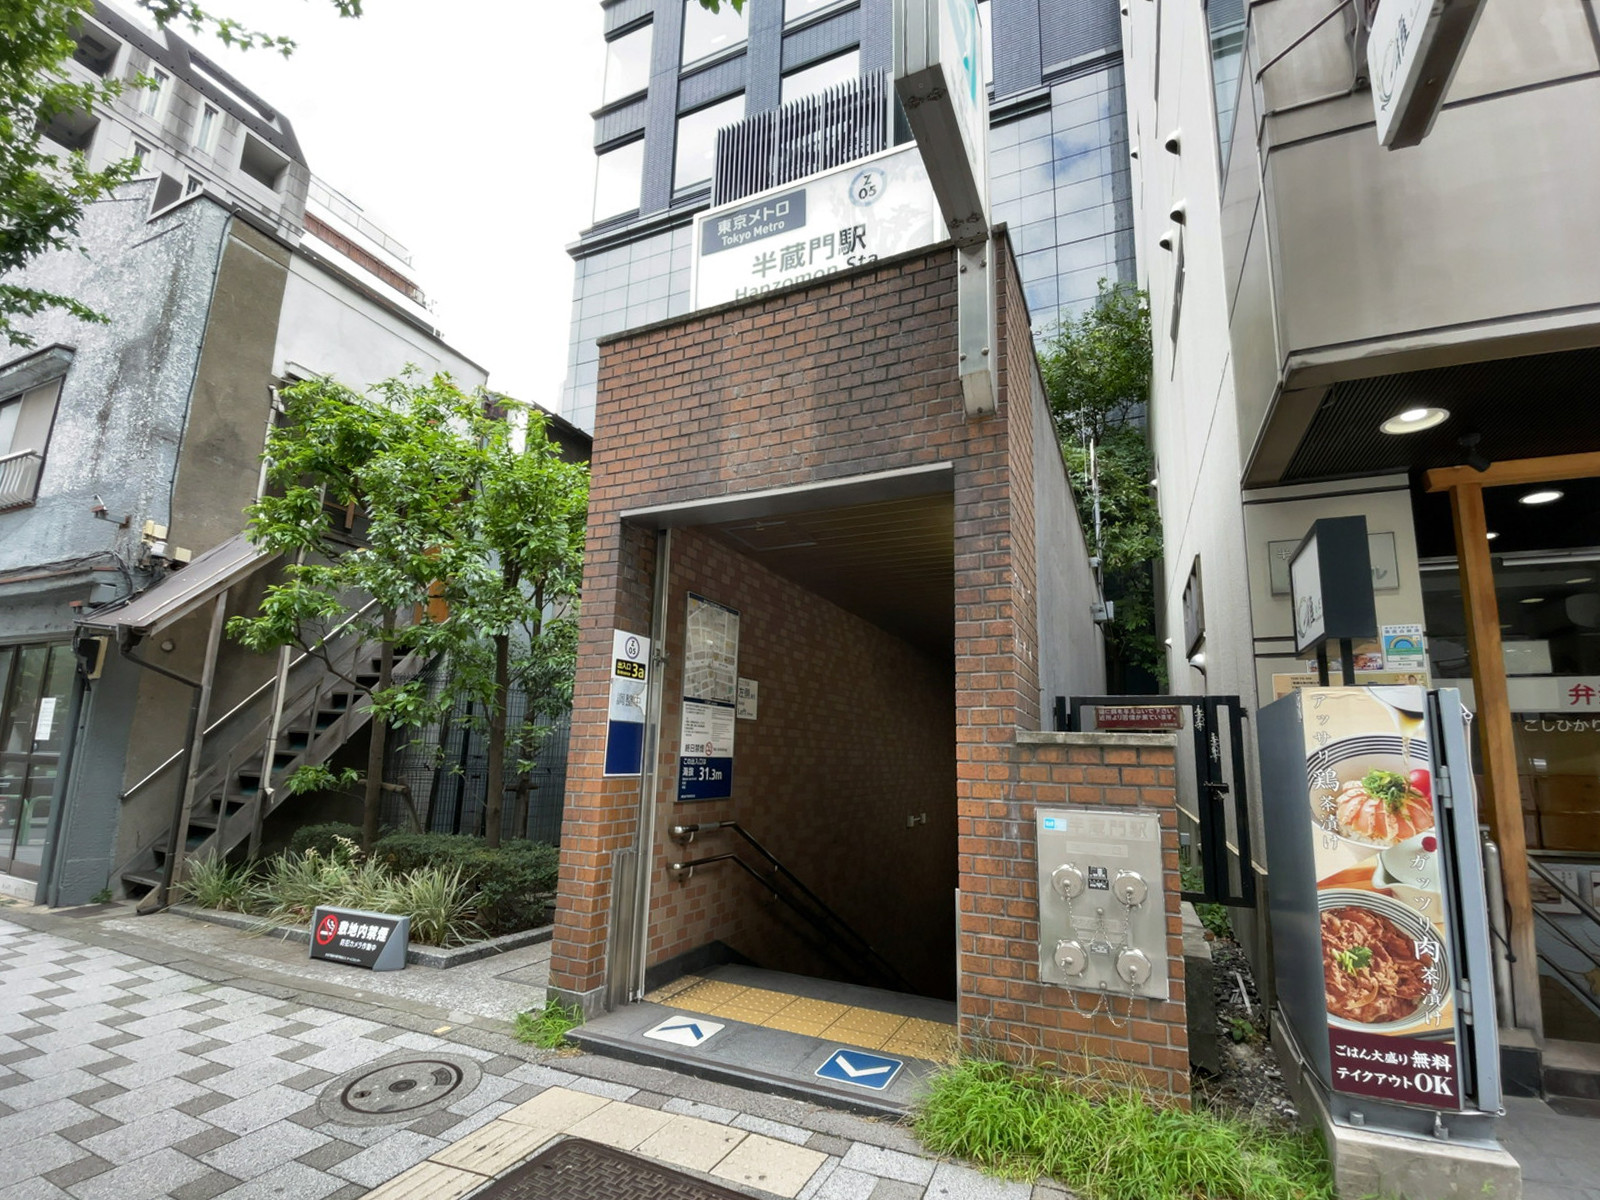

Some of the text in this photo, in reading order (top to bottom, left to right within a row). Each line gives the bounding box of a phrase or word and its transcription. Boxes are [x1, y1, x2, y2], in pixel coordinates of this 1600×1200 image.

[863, 174, 873, 186] Z
[858, 185, 877, 200] 05
[717, 200, 790, 237] 東京メトロ
[721, 220, 785, 247] Tokyo Metro
[751, 223, 867, 279] 半蔵門駅
[631, 663, 645, 679] 3a
[1568, 683, 1600, 705] 弁
[1524, 718, 1600, 732] こしひかり
[698, 766, 723, 781] 31.3m
[1310, 694, 1340, 850] アッサリ鶏茶漬け
[337, 920, 390, 943] 敷地内禁煙
[1409, 855, 1442, 1027] ガッツリ肉茶漬け
